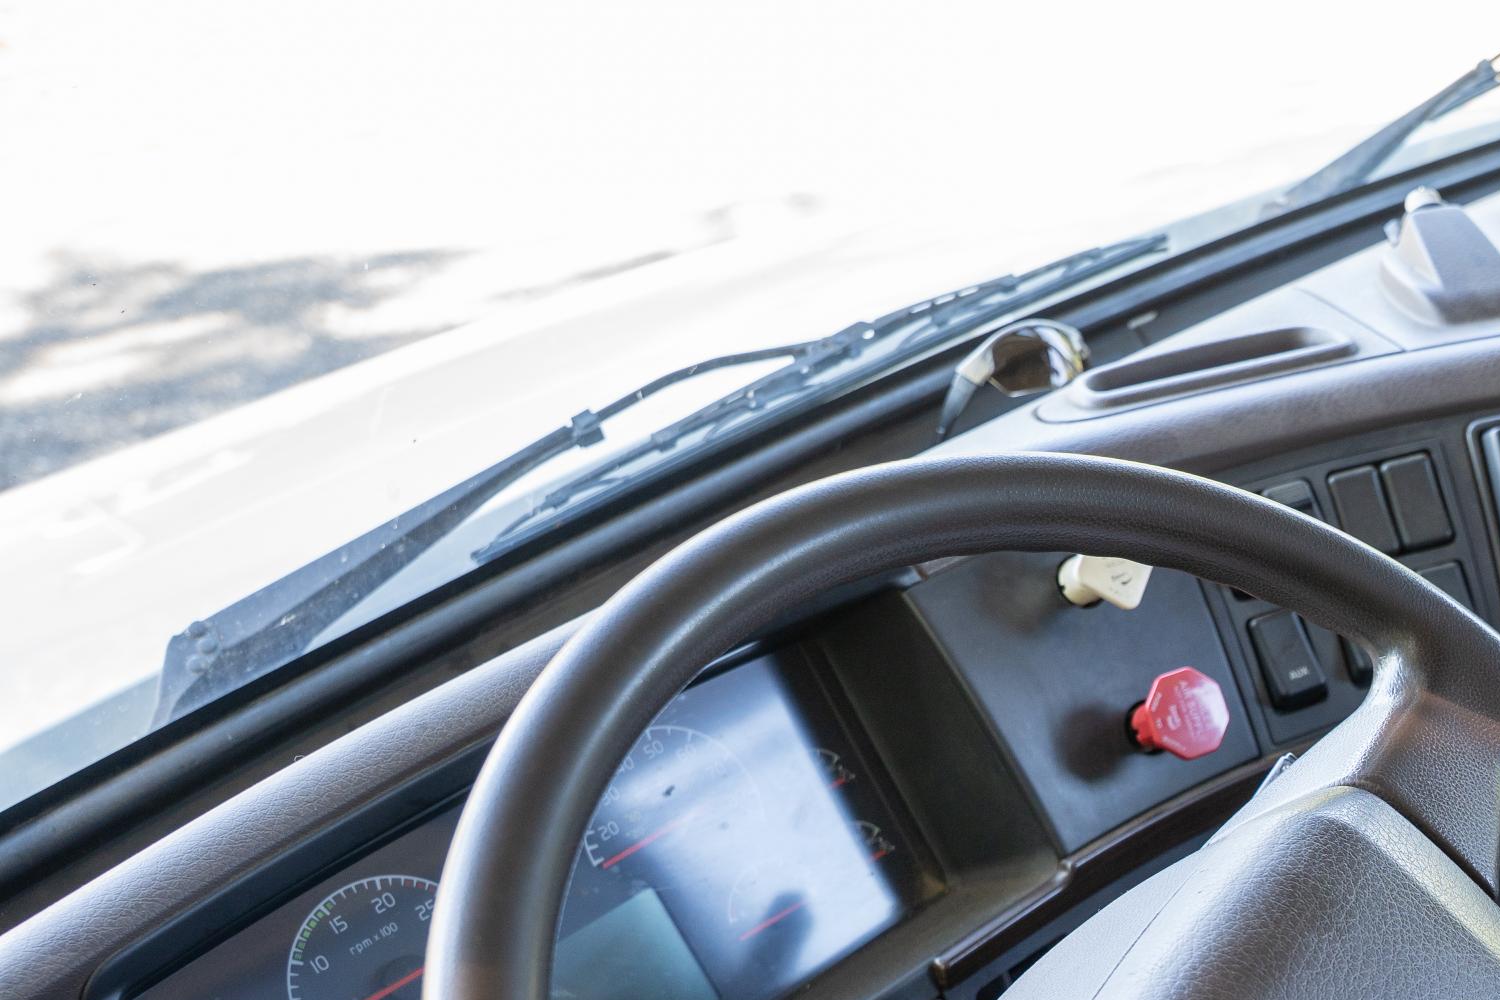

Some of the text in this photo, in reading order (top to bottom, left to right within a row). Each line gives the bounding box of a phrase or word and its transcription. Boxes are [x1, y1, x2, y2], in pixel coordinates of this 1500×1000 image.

[644, 740, 664, 759] 50
[598, 821, 619, 841] 20
[371, 892, 396, 914] 20
[328, 915, 349, 935] 15
[349, 936, 373, 956] rpm
[380, 922, 399, 938] 100
[310, 955, 330, 974] 10
